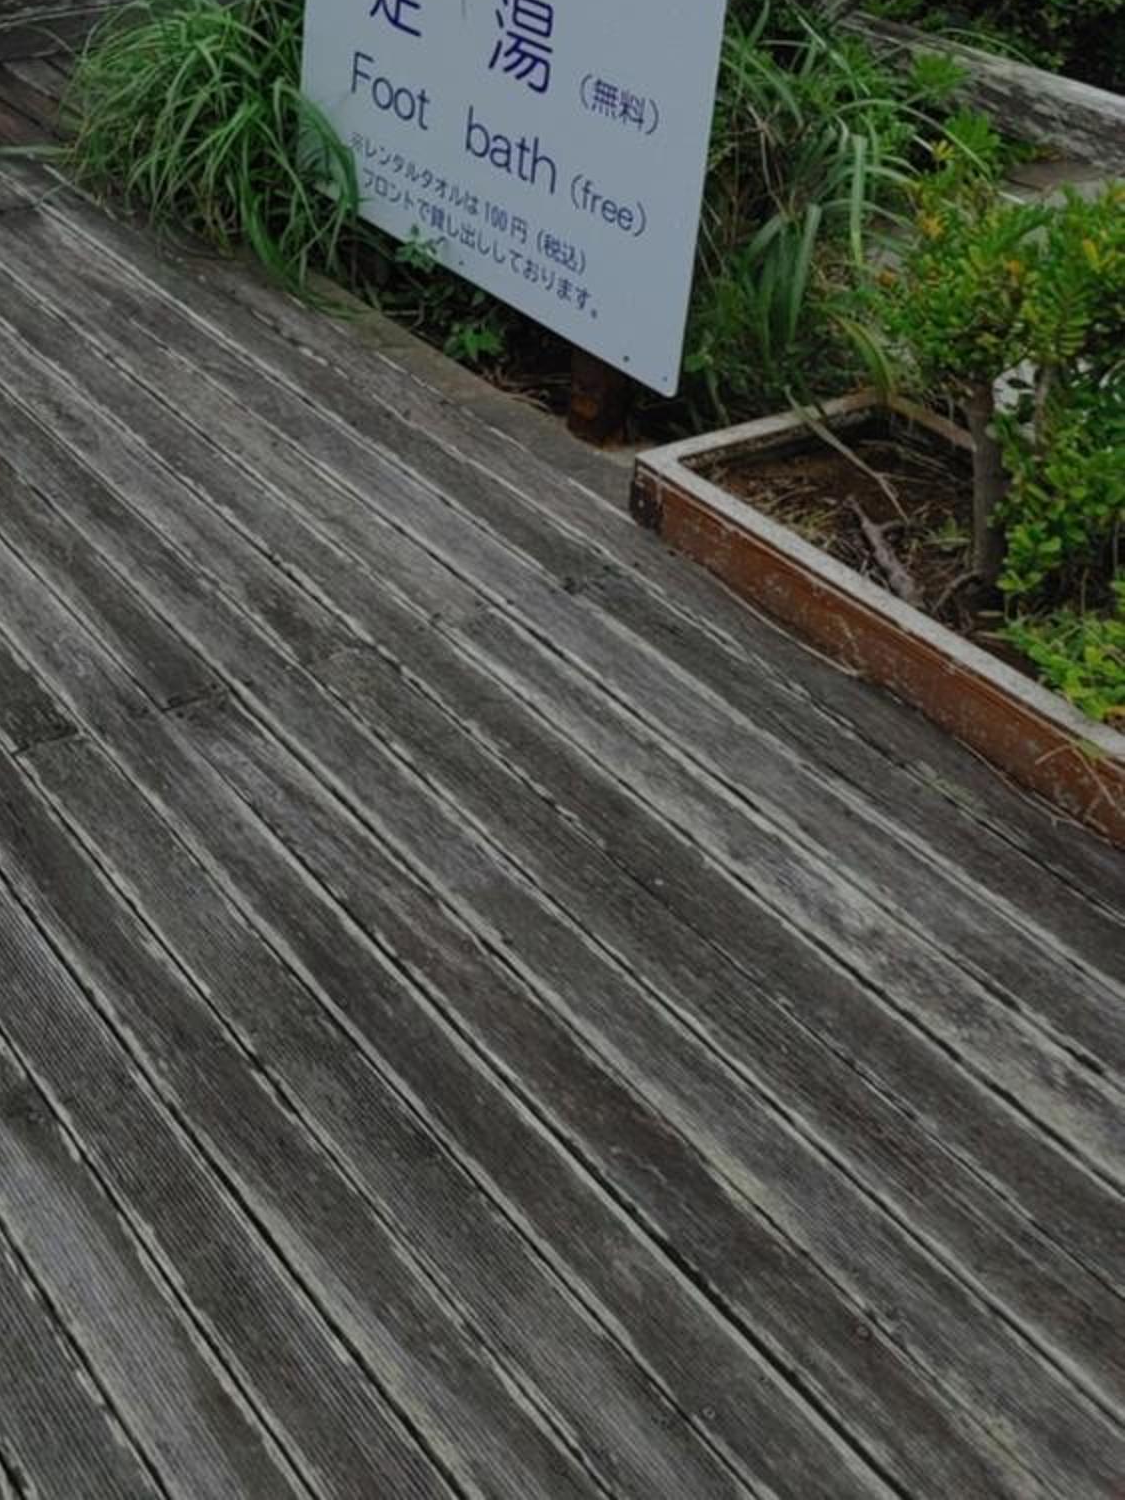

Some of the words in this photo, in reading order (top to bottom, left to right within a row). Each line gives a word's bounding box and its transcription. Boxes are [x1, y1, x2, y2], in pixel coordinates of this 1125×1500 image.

[351, 50, 431, 132] Foot
[464, 103, 558, 196] bath
[570, 173, 647, 237] (free)
[579, 73, 660, 135] （無料）
